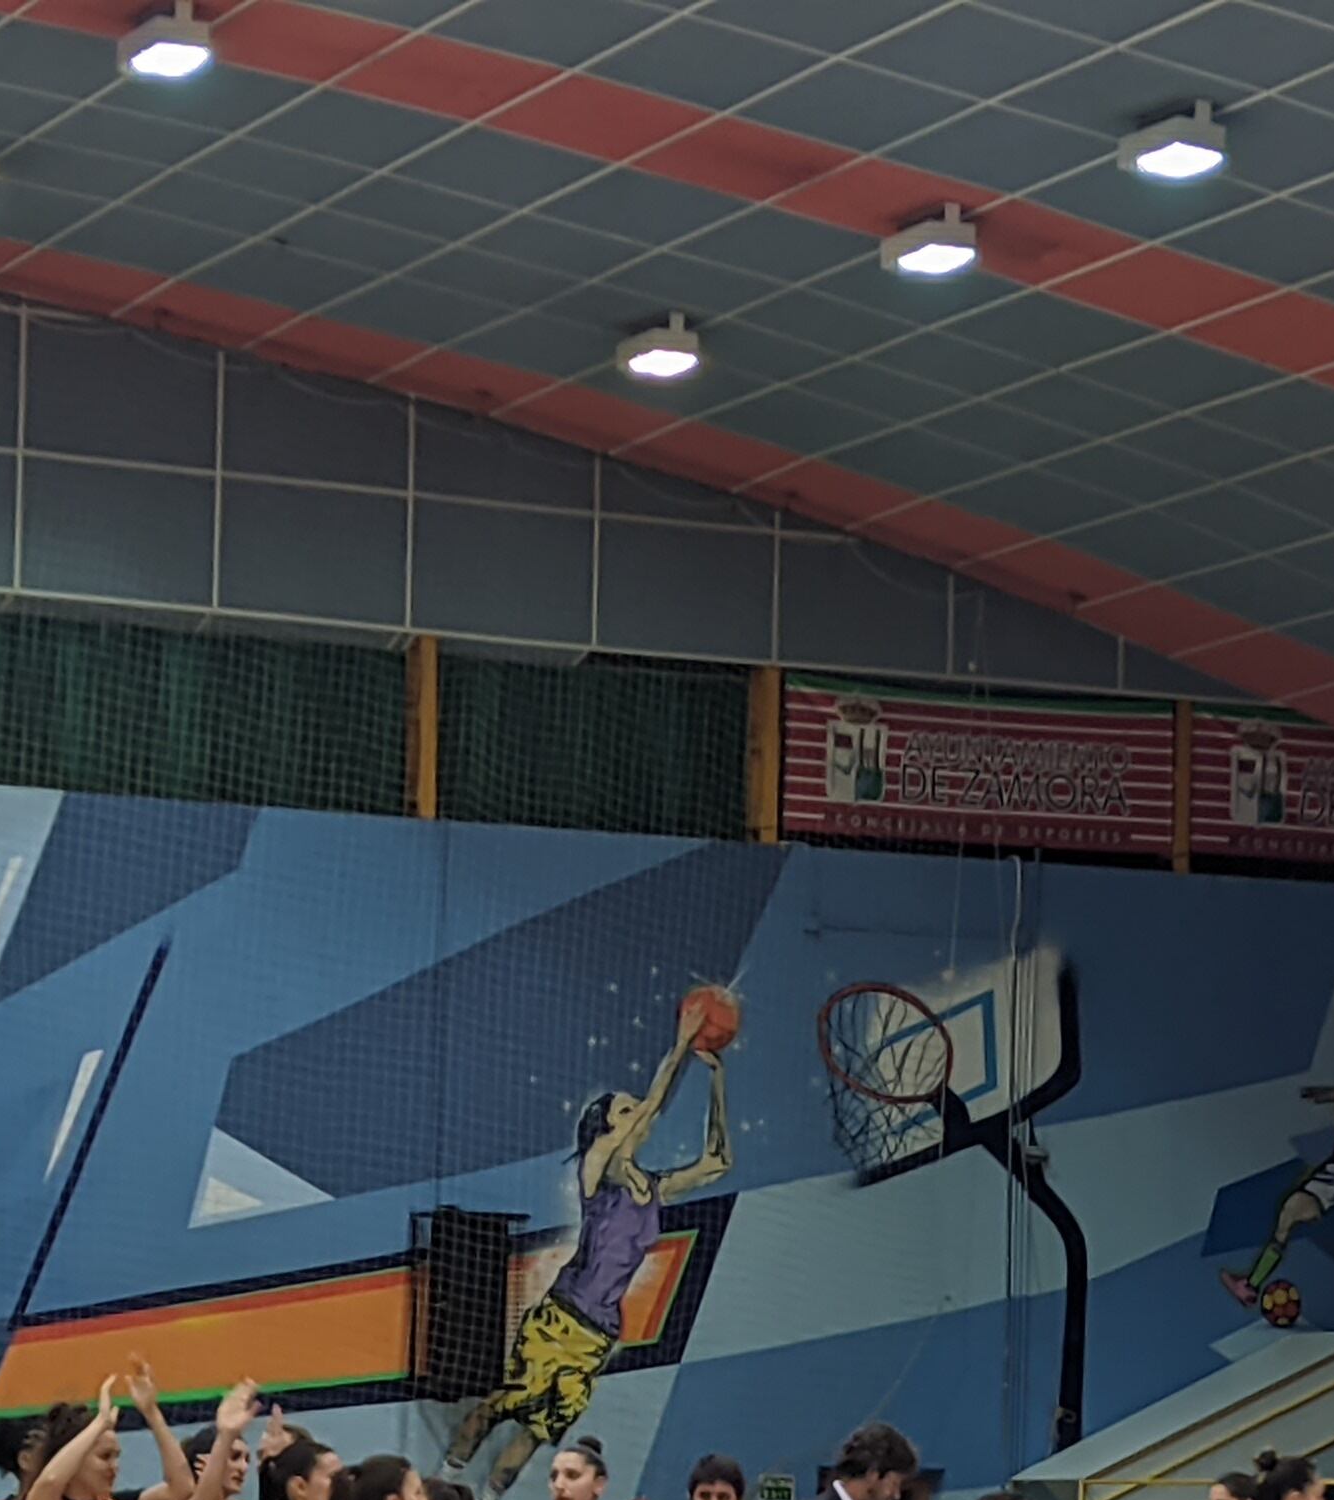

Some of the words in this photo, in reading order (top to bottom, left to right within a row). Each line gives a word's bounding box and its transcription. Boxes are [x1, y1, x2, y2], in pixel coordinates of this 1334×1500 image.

[902, 730, 1131, 774] AYUNTAMIENTO
[899, 762, 951, 804] DE
[960, 767, 1131, 818] ZAMORA
